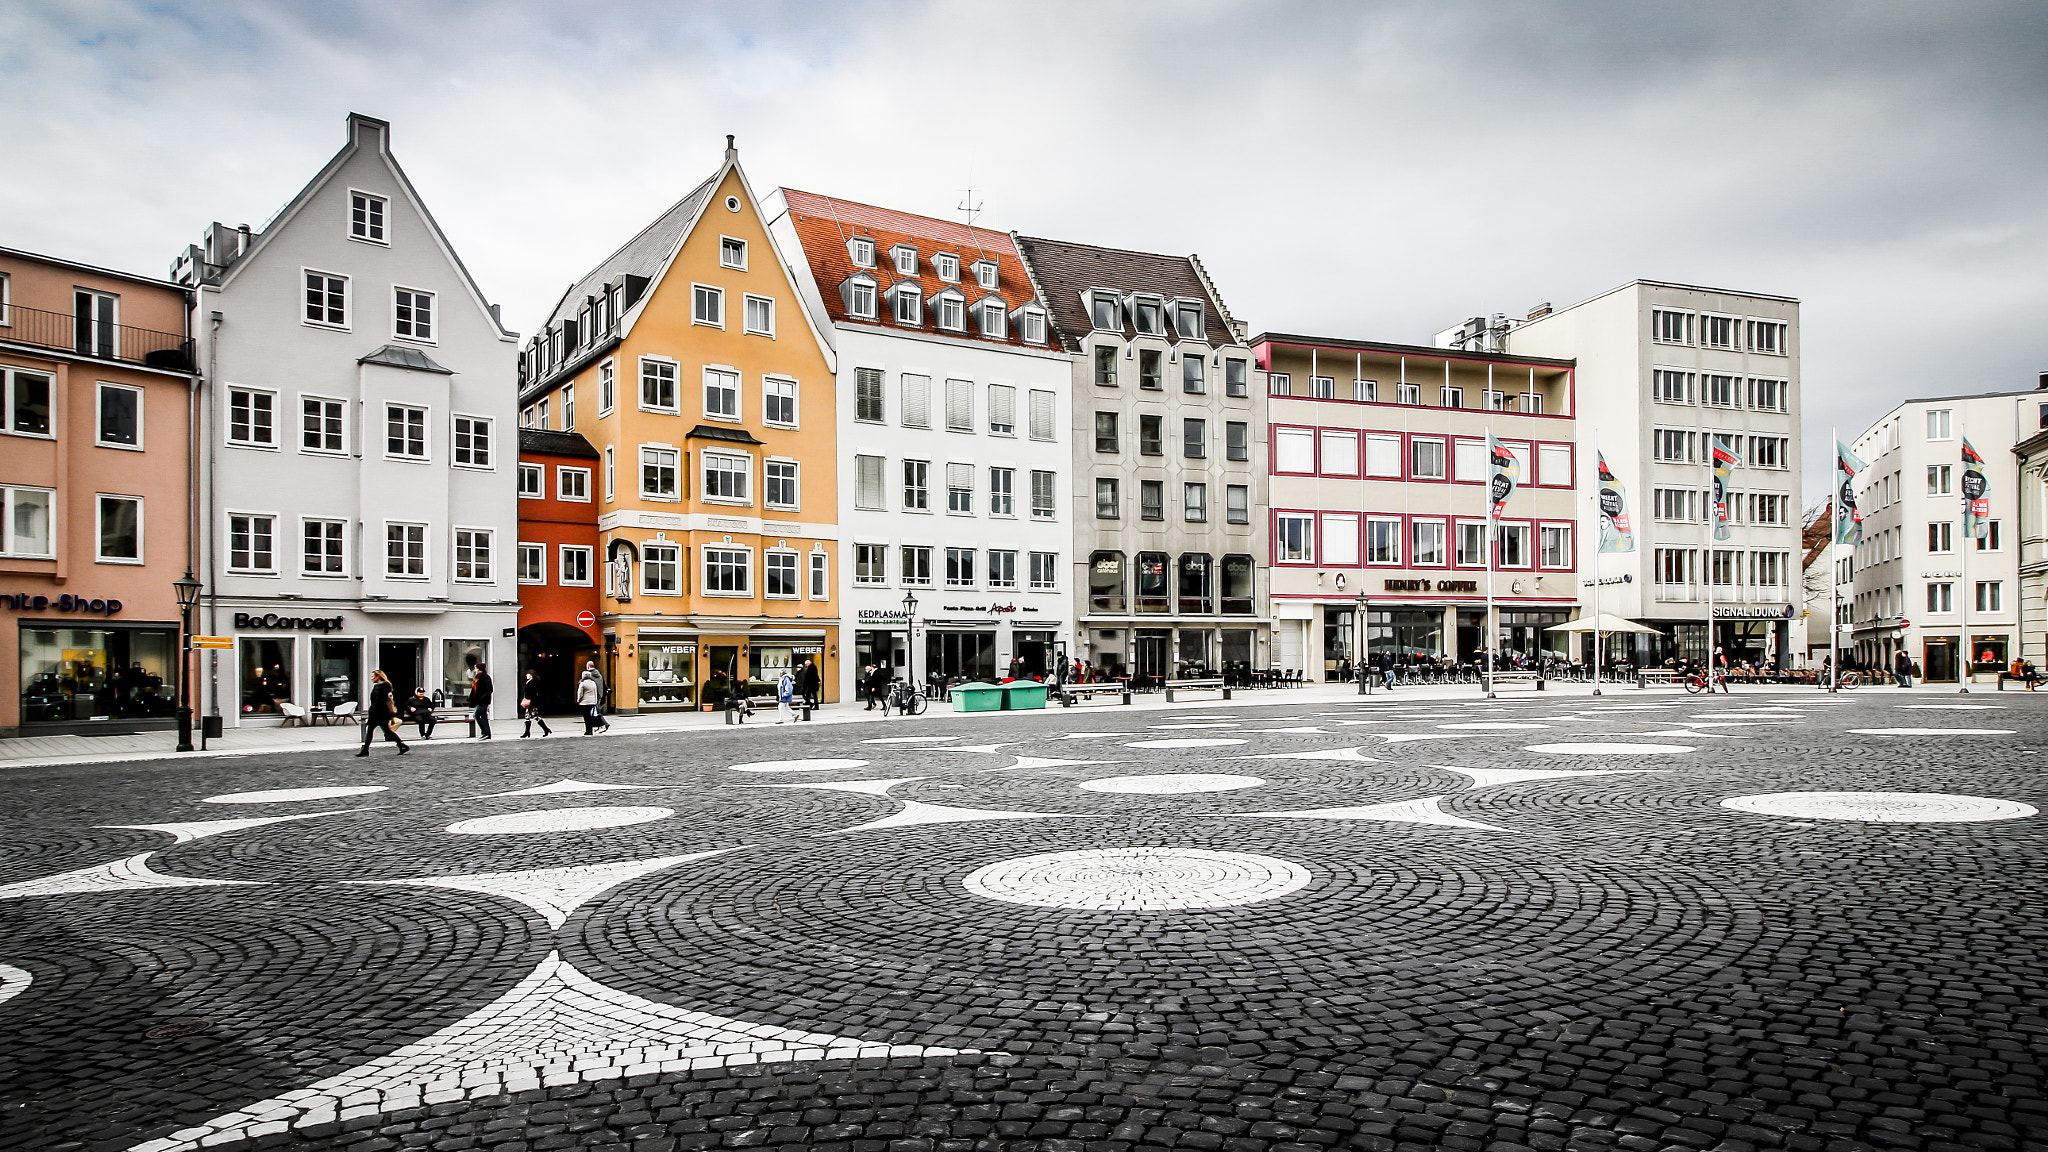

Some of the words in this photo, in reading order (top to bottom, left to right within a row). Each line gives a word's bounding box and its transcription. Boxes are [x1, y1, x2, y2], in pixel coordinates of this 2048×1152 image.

[1384, 578, 1431, 591] HENRY'S
[1437, 580, 1477, 592] COFFEE
[858, 609, 907, 619] KEDPLASMA
[1713, 606, 1750, 617] SIGNAL
[1752, 606, 1783, 617] IDUNA
[234, 612, 345, 633] BoConcept
[661, 645, 696, 654] WEBER
[792, 646, 822, 654] WEBER
